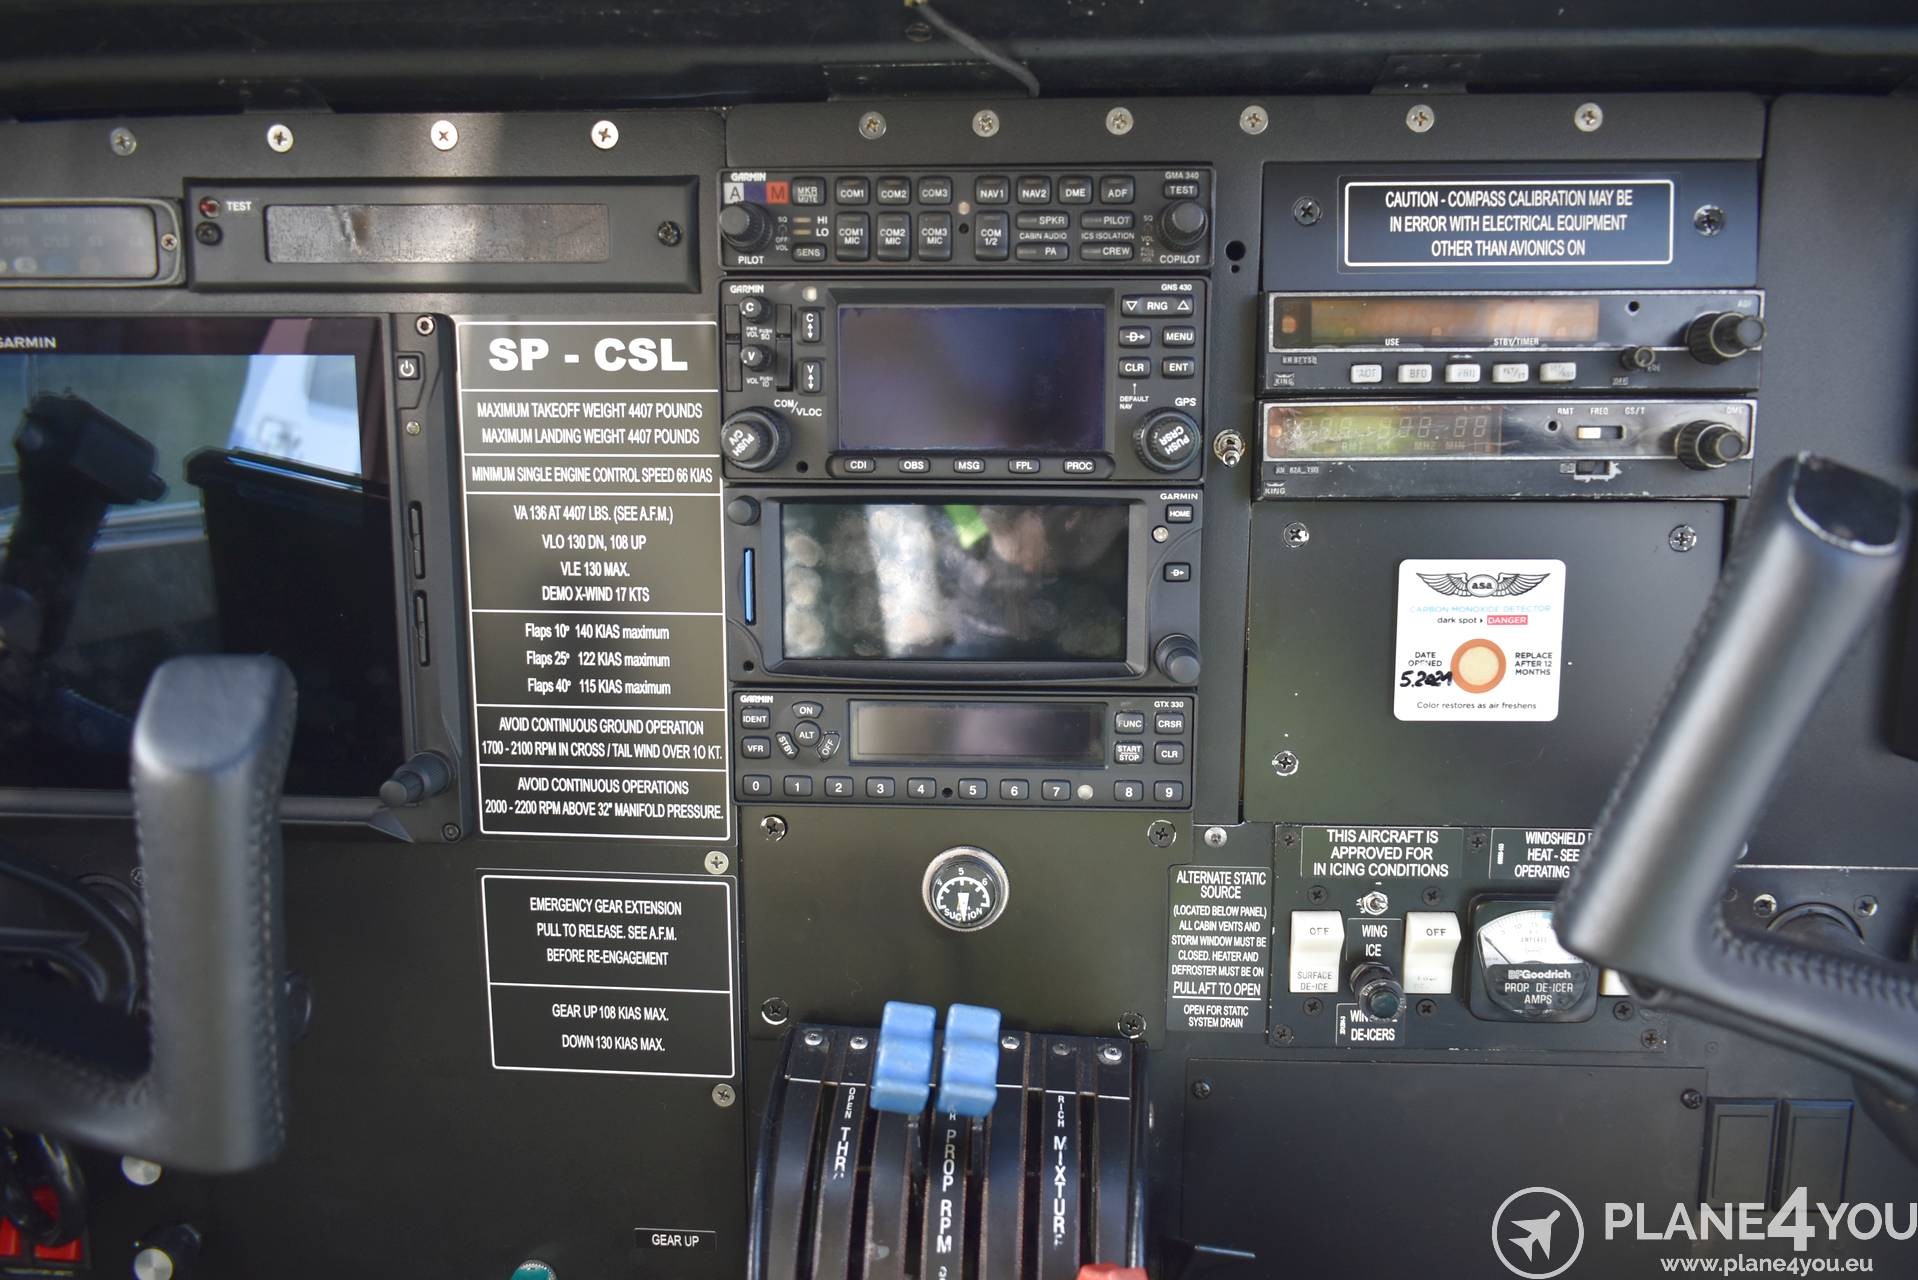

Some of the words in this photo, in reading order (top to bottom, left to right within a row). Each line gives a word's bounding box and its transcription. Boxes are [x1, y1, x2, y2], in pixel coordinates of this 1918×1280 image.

[730, 187, 741, 200] A
[771, 186, 785, 199] M
[840, 189, 864, 198] COM1
[881, 190, 907, 199] COM2
[922, 189, 948, 198] COM3
[980, 189, 1004, 198] NAV1
[1022, 189, 1047, 198] NAV2
[1066, 189, 1086, 197] DME
[1108, 189, 1128, 198] ADF
[1170, 186, 1194, 194] TEST
[1385, 191, 1438, 208] CAUTION
[1448, 191, 1506, 207] COMPASS
[1509, 190, 1586, 207] CALIBRATION
[1589, 190, 1614, 206] MAY
[1617, 189, 1633, 206] BE
[226, 201, 252, 212] TEST
[1039, 216, 1065, 225] SPKR
[1104, 216, 1130, 225] PILOT
[1390, 216, 1402, 232] IN
[1404, 216, 1447, 232] ERROR
[1450, 216, 1480, 231] WITH
[1482, 215, 1555, 231] ELECTRICAL
[1557, 214, 1627, 231] EQUIPMENT
[796, 249, 821, 257] SENS
[1045, 247, 1057, 256] PA
[1103, 247, 1130, 256] CREW
[738, 256, 765, 265] PILOT
[1160, 255, 1200, 264] COPILOT
[730, 285, 764, 294] GARMIN
[1147, 302, 1168, 311] RNG
[1166, 333, 1193, 341] MENU
[1494, 337, 1539, 346] STBY/TIMER
[1385, 338, 1399, 346] USE
[489, 338, 549, 371] SP
[564, 354, 580, 363] -
[594, 338, 688, 371] CSL
[1125, 363, 1144, 372] CLR
[1169, 363, 1188, 372] ENT
[1175, 397, 1197, 406] GPS
[477, 402, 529, 418] MAXIMUM
[531, 402, 580, 418] TAKEOFF
[582, 402, 626, 418] WEIGHT
[628, 403, 653, 418] 4407
[655, 403, 703, 418] POUNDS
[850, 461, 867, 469] CDI
[904, 461, 924, 470] OBS
[958, 461, 980, 470] MSG
[1016, 462, 1032, 470] FPL
[1067, 462, 1093, 470] PROC
[472, 466, 515, 482] MINIMUM
[517, 467, 552, 482] SINGLE
[554, 467, 591, 482] ENGINE
[593, 467, 640, 482] CONTROL
[642, 467, 674, 483] SPEED
[676, 468, 688, 483] 66
[690, 468, 713, 483] KIAS
[1169, 510, 1191, 518] HOME
[542, 534, 565, 550] VLO
[567, 534, 586, 550] 130
[588, 535, 607, 551] DN,
[610, 535, 628, 550] 108
[630, 535, 646, 550] UP
[1472, 581, 1493, 590] asa
[1437, 616, 1456, 624] dark
[1459, 616, 1477, 625] spot
[1487, 616, 1527, 624] DANGER
[799, 706, 813, 715] ON
[1501, 702, 1536, 710] freshens
[743, 715, 767, 723] IDENT
[1118, 720, 1142, 728] FUNC
[1158, 720, 1182, 728] CRSR
[799, 731, 814, 739] ALT
[778, 736, 794, 756] STBY
[822, 739, 833, 756] OFF
[1161, 750, 1178, 758] CLR
[518, 777, 549, 791] AVOID
[551, 777, 620, 793] CONTINUOUS
[622, 779, 689, 795] OPERATIONS
[752, 781, 760, 791] 0
[1125, 787, 1133, 797] 8
[1165, 787, 1173, 797] 9
[1327, 830, 1357, 843] THIS
[1358, 830, 1423, 843] AIRCRAFT
[1426, 831, 1439, 844] IS
[1526, 832, 1586, 845] WINDSHIELD
[1331, 846, 1403, 860] APPROVED
[1406, 847, 1433, 860] FOR
[1313, 863, 1326, 876] IN
[1330, 863, 1365, 876] ICING
[1368, 863, 1449, 877] CONDITIONS
[1515, 865, 1570, 878] OPERATING
[1177, 871, 1231, 885] ALTERNATE
[1234, 872, 1266, 885] STATIC
[1200, 886, 1241, 899] SOURCE
[530, 897, 593, 912] EMERGENCY
[595, 899, 623, 913] GEAR
[625, 900, 682, 915] EXTENSION
[1362, 925, 1388, 938] WING
[1426, 928, 1447, 936] OFF
[1365, 944, 1382, 957] ICE
[1508, 969, 1572, 980] BFGoodrich
[1174, 982, 1197, 995] PULL
[1198, 983, 1217, 995] AFT
[1219, 983, 1231, 995] TO
[1233, 983, 1260, 996] OPEN
[1536, 983, 1573, 993] DE-ICER
[1524, 995, 1553, 1004] AMPS
[552, 1003, 582, 1018] GEAR
[584, 1005, 597, 1018] UP
[599, 1005, 616, 1019] 108
[618, 1006, 642, 1020] KIAS
[644, 1007, 669, 1021] MAX.
[1351, 1028, 1395, 1041] DE-ICERS
[843, 1086, 856, 1119] OPEN
[1057, 1095, 1066, 1128] RICH
[942, 1129, 957, 1192] PROP
[936, 1199, 953, 1253] RPM
[652, 1233, 682, 1246] GEAR
[684, 1235, 700, 1247] UP
